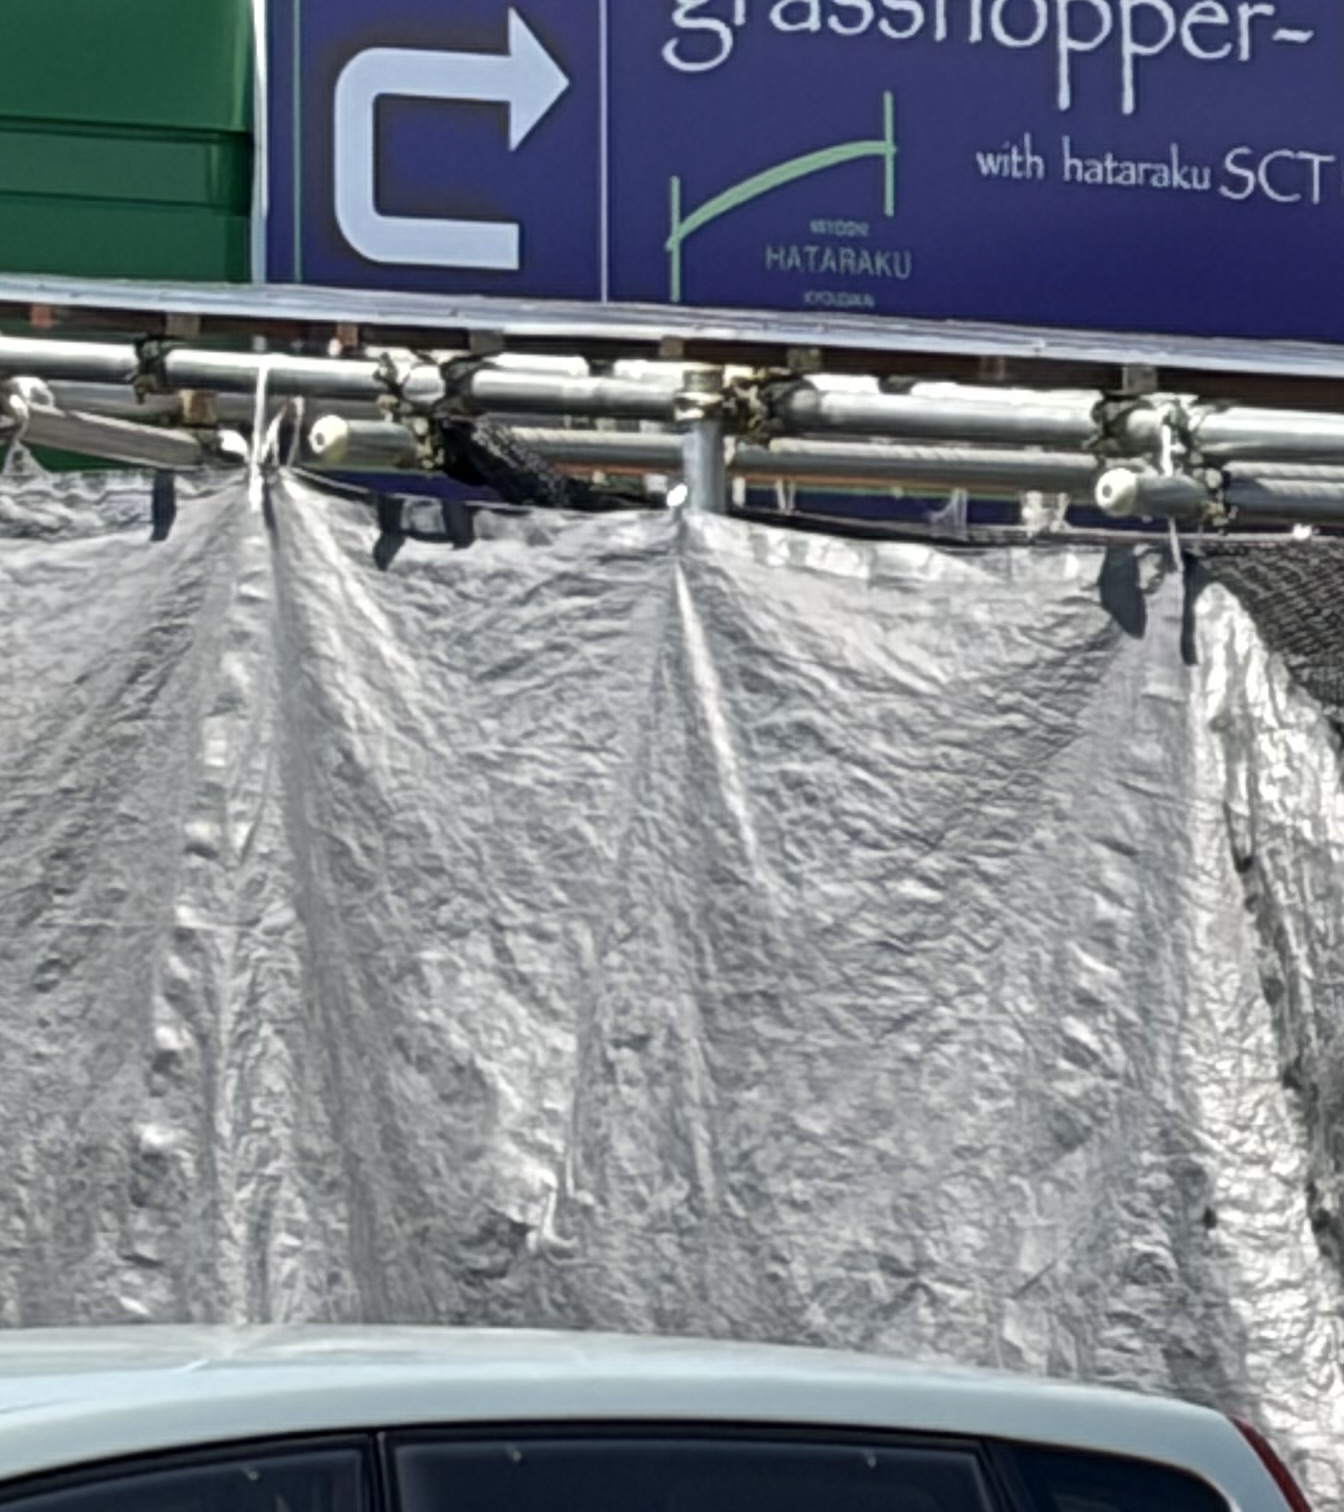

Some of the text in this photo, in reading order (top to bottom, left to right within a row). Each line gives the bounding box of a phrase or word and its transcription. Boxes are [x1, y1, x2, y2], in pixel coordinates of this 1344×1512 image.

[976, 133, 1045, 180] with
[1062, 136, 1212, 190] hataraku
[1218, 146, 1336, 204] SCT
[765, 244, 913, 280] HATARAKU
